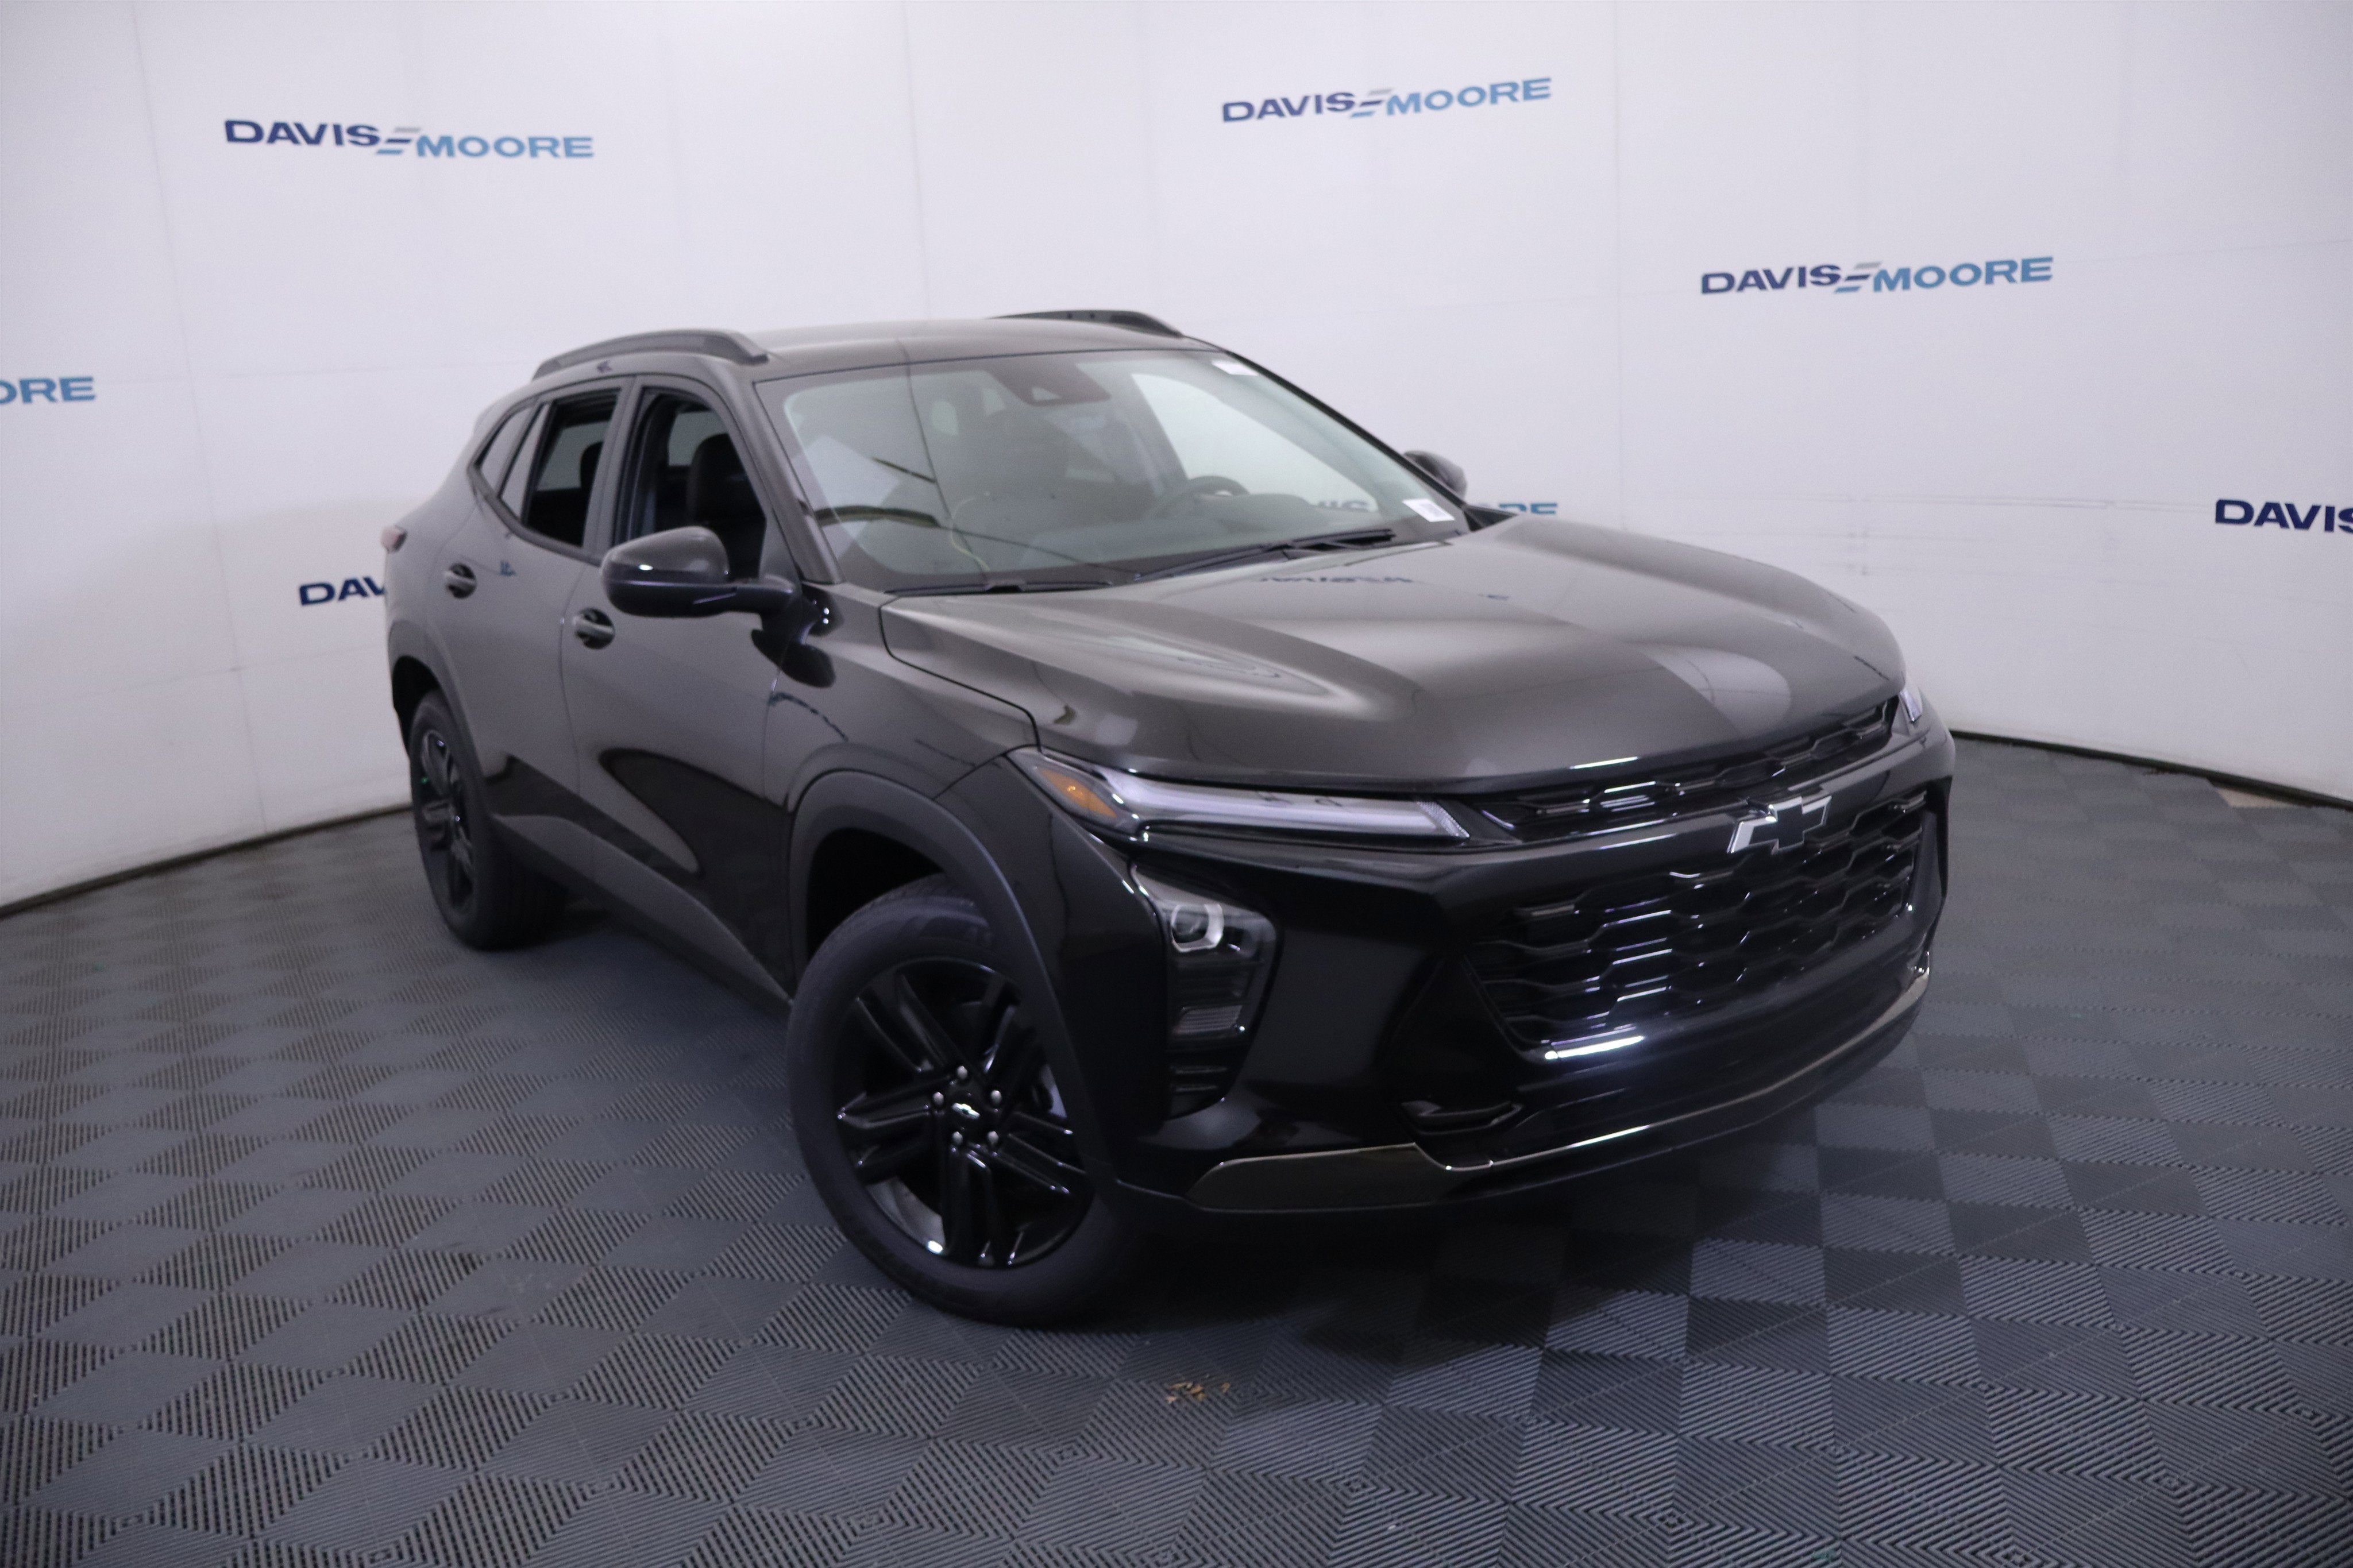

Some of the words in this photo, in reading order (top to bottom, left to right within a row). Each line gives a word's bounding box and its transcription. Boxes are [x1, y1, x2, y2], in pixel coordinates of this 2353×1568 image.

[1222, 92, 1356, 123] DAVIS
[1386, 77, 1552, 116] MOORE
[224, 119, 381, 147] DAVIS
[416, 134, 593, 158] MOORE
[1701, 264, 1842, 295] DAVIS
[1873, 256, 2054, 292] MOORE
